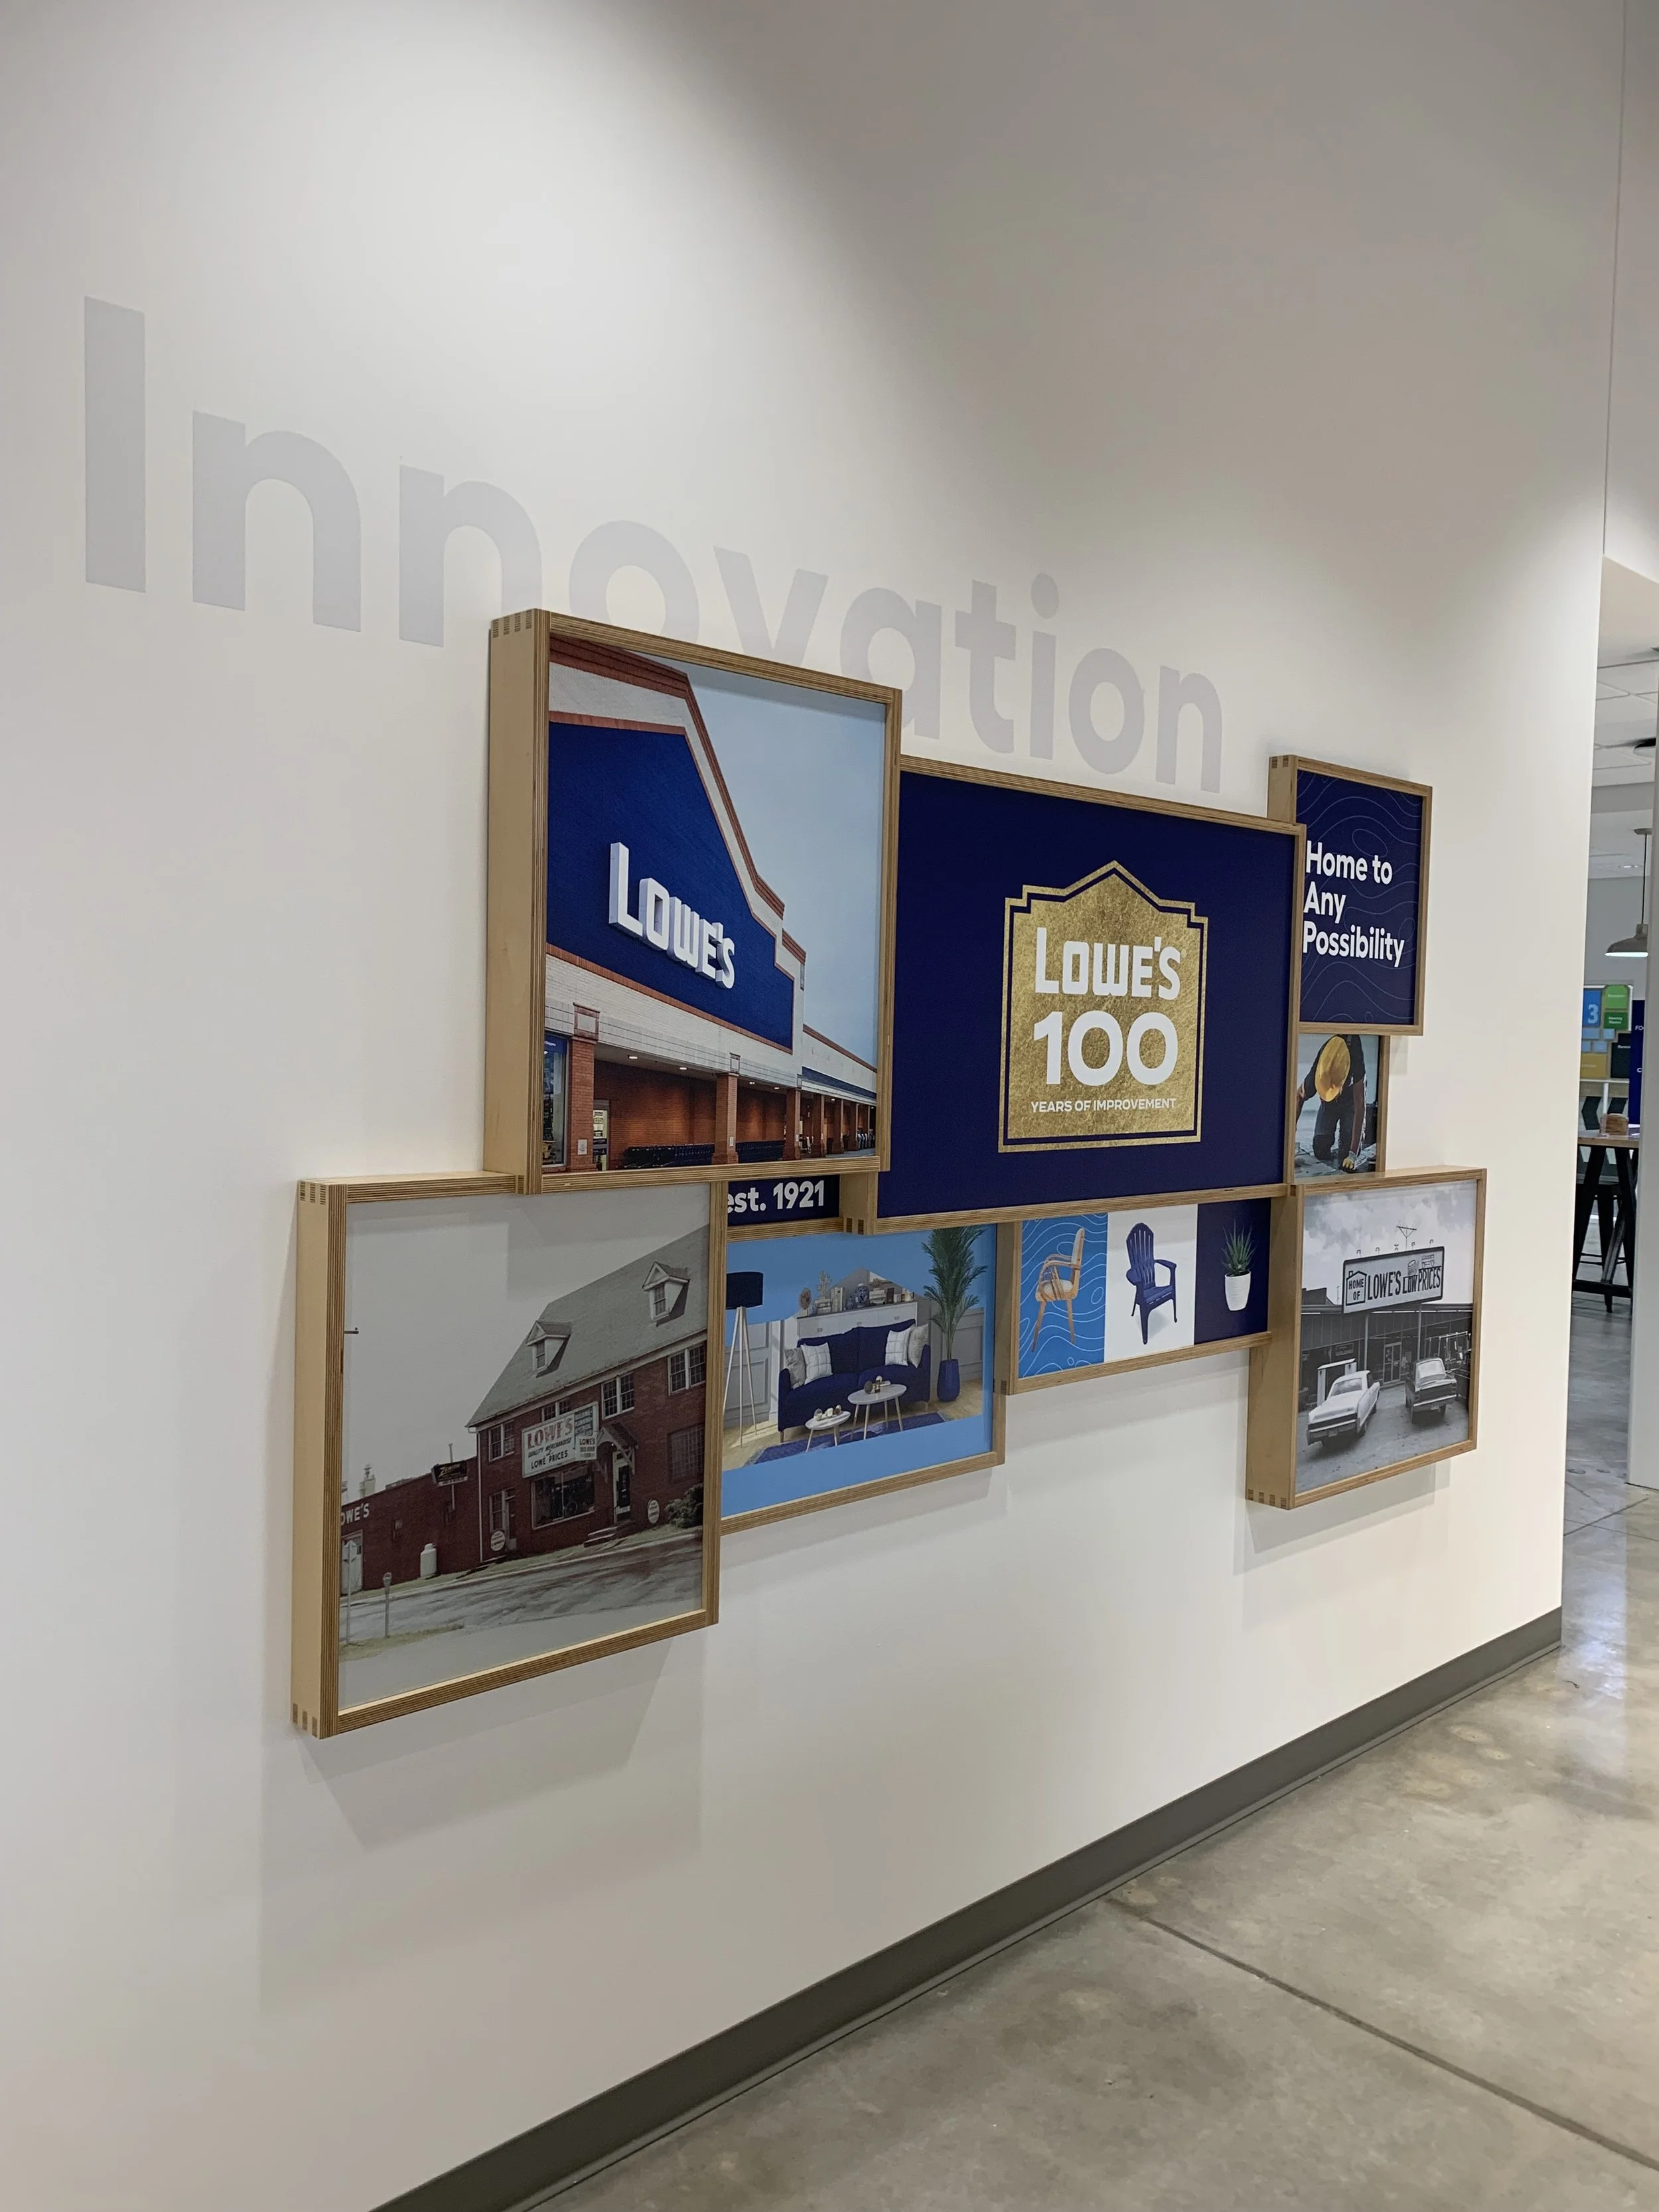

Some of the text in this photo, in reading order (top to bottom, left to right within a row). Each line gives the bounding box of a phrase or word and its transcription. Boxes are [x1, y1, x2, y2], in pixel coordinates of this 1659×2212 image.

[85, 296, 1222, 793] Innovation
[1306, 840, 1393, 885] Home to
[609, 842, 735, 989] LOWE'S
[1303, 881, 1346, 923] Any
[1035, 927, 1181, 1000] LOWE'S
[1303, 921, 1405, 968] Possibility
[1588, 1004, 1599, 1023] 3
[1033, 1010, 1179, 1086] 100
[1031, 1098, 1177, 1113] YEARS OF IMPROVEMENT
[773, 1180, 824, 1210] 1921
[1348, 1278, 1364, 1290] HOME
[1353, 1291, 1360, 1301] OF
[1367, 1266, 1441, 1301] LOWE'S LOW PRICES
[549, 1449, 568, 1463] PRICES
